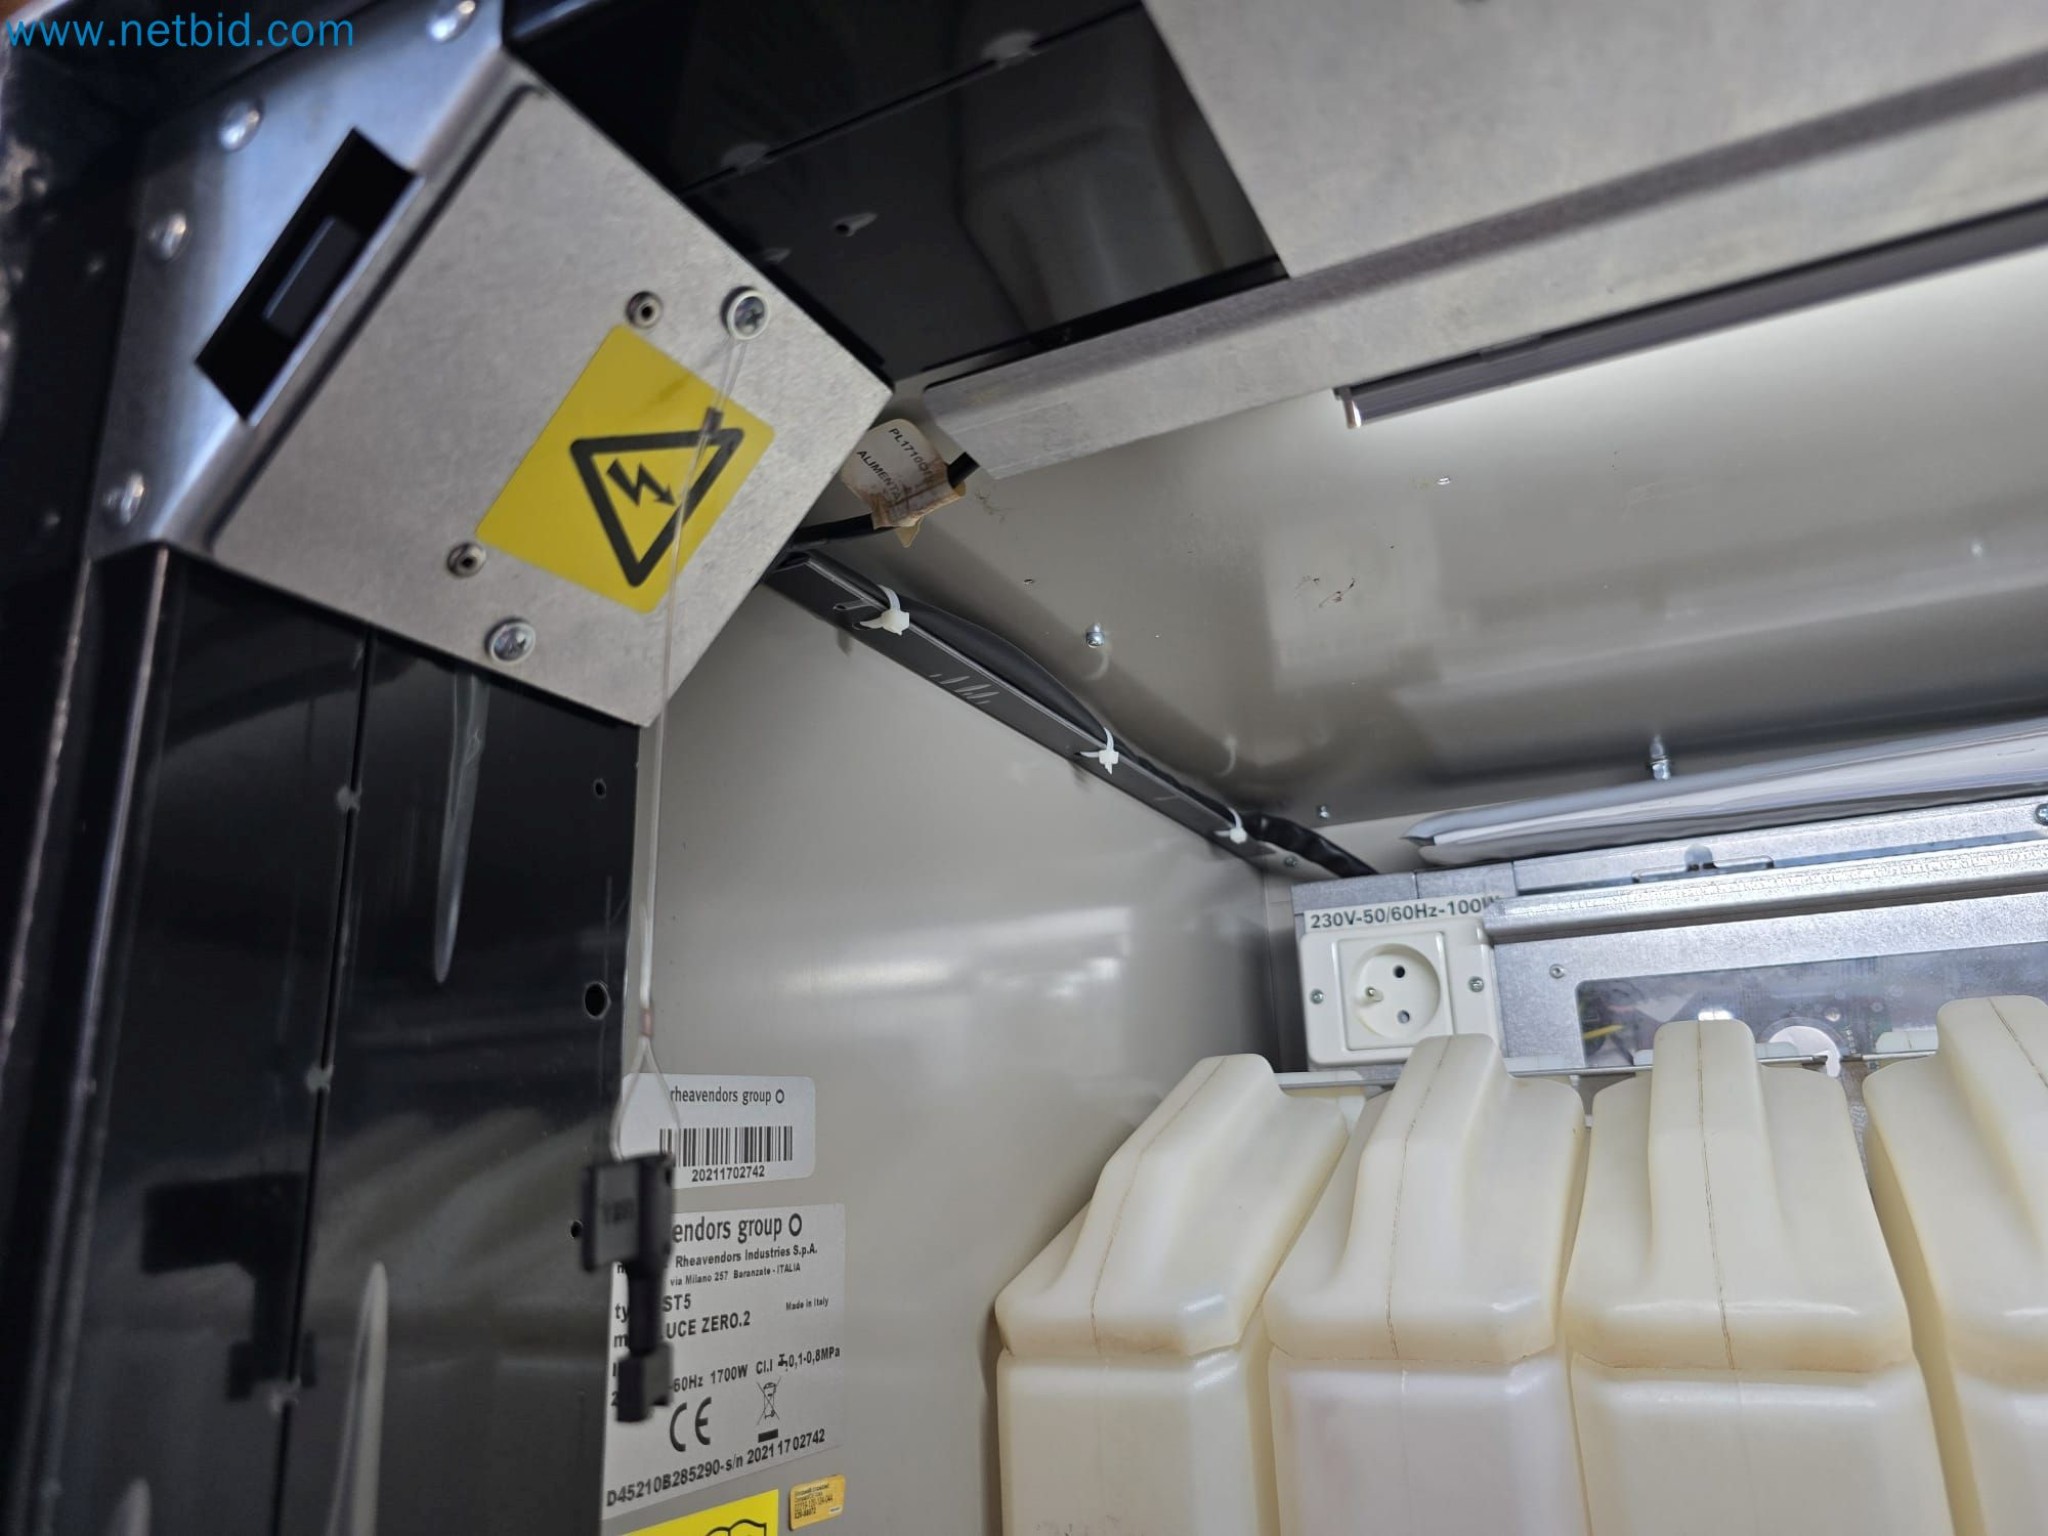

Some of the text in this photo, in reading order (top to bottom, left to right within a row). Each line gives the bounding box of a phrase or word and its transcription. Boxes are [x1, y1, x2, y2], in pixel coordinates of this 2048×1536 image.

[670, 1085, 772, 1106] rheavendors group
[691, 1165, 765, 1183] 20211702742
[672, 1215, 783, 1244] endors group
[675, 1242, 818, 1268] Rheavendors Industries S.p.A.
[670, 1277, 683, 1287] via
[714, 1270, 729, 1282] 257
[777, 1263, 801, 1275] ITALIA
[785, 1296, 830, 1311] Made in Italy
[666, 1310, 752, 1339] UCE ZERO.2
[710, 1364, 748, 1385] 1700W
